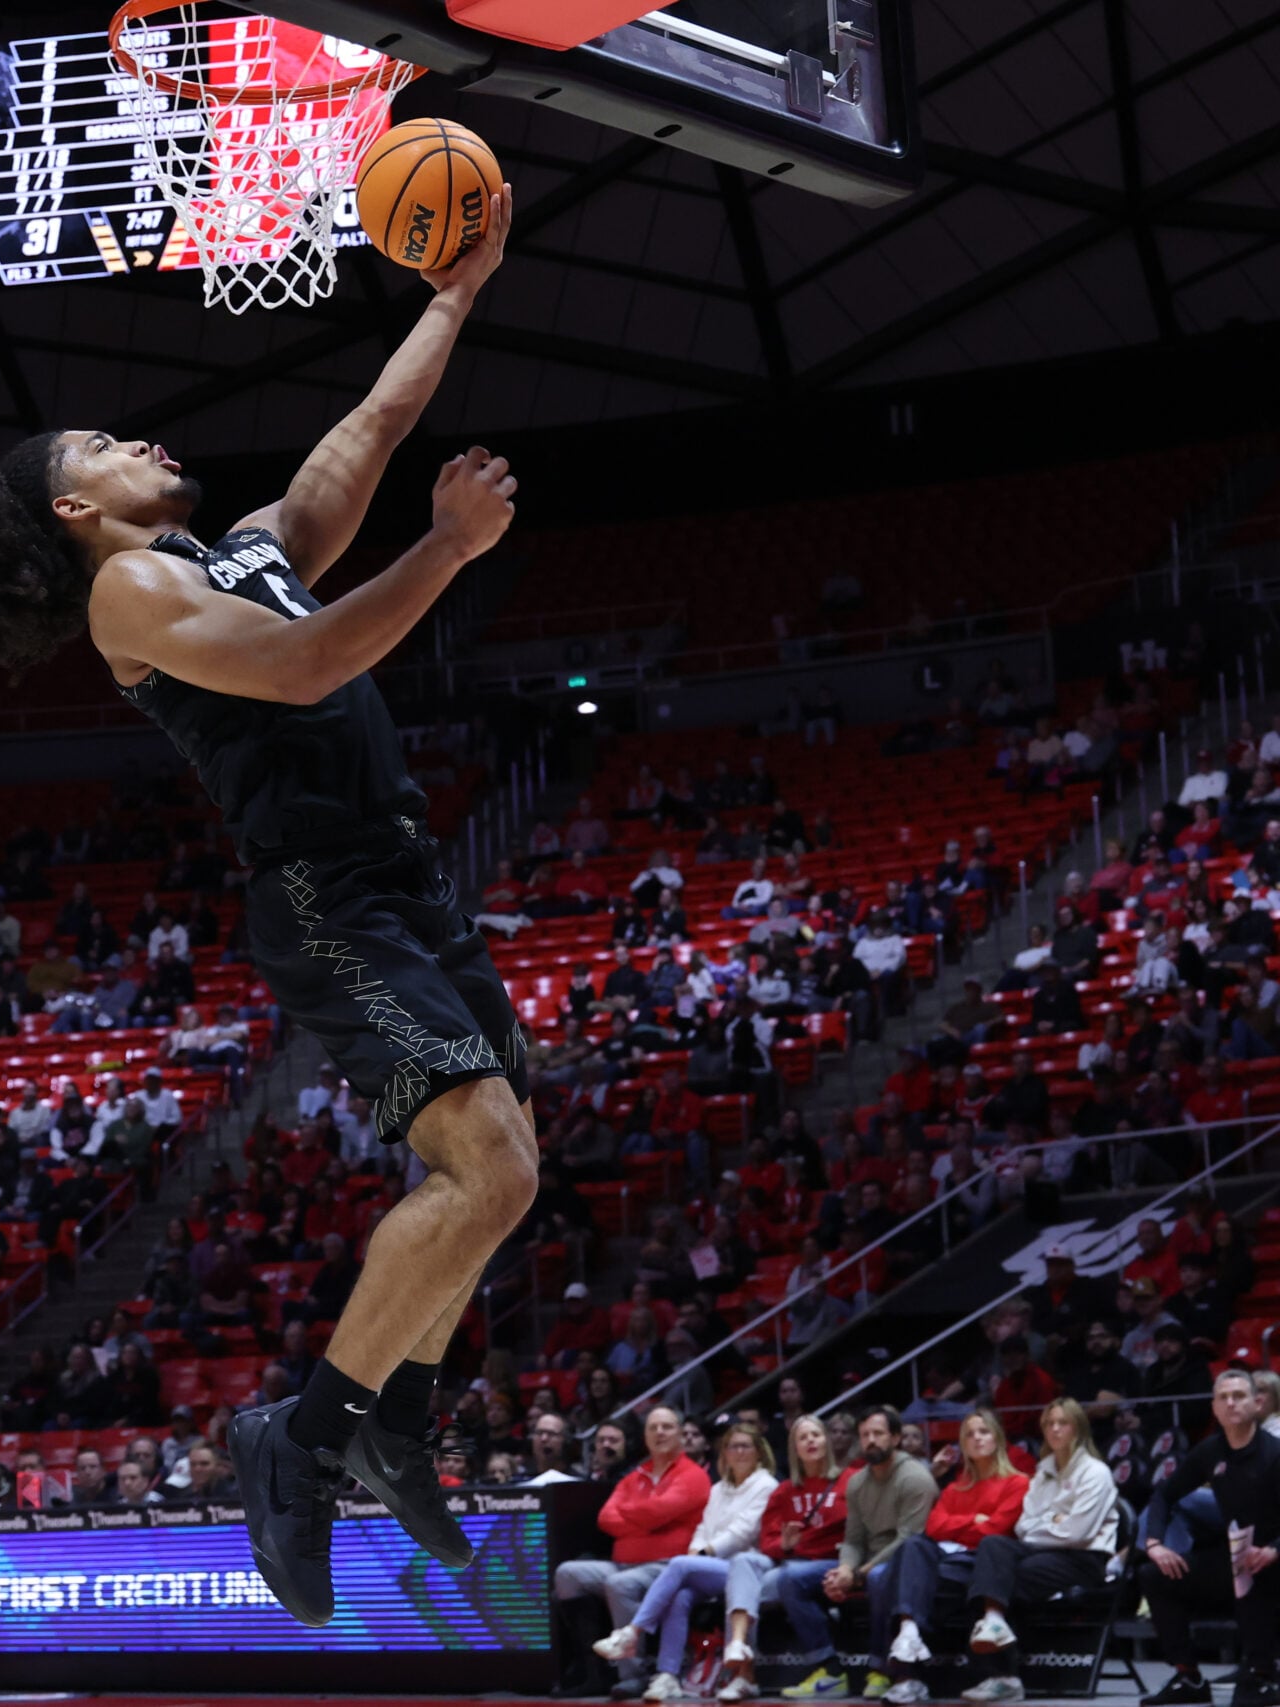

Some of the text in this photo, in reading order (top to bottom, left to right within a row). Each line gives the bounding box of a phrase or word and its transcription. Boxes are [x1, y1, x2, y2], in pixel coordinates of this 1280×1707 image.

[134, 187, 153, 203] FT
[20, 217, 62, 257] 31
[124, 210, 164, 231] 7:47
[330, 230, 373, 248] EALT
[402, 203, 436, 263] NCAA
[207, 542, 292, 590] COLORA
[922, 666, 943, 691] L
[93, 1571, 208, 1606] CREDIT
[209, 1570, 278, 1605] UNI
